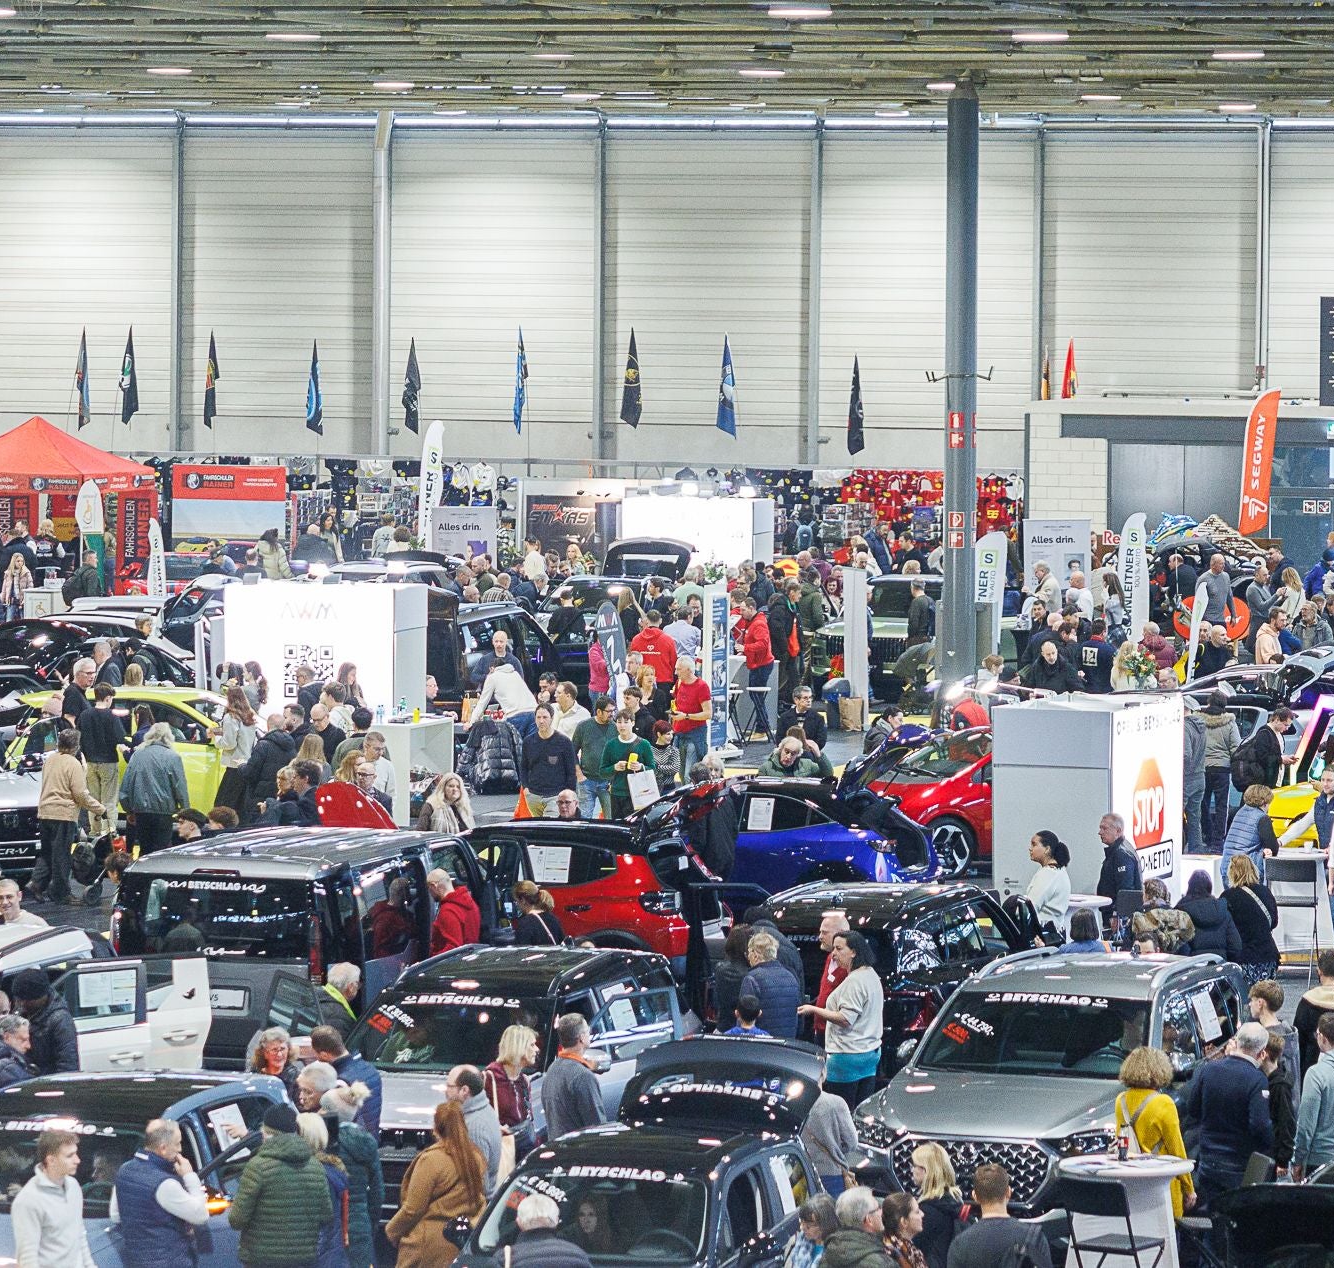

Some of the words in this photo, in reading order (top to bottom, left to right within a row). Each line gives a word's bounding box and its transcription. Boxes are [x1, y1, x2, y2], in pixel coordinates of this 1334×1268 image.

[1251, 413, 1267, 490] SEGWAY
[0, 498, 11, 538] SCHULEN
[125, 500, 136, 558] FAHRSCHULEN
[137, 500, 151, 558] RAINER
[438, 523, 460, 531] Alles
[462, 523, 482, 531] drin.
[1031, 536, 1054, 544] Alles
[1056, 535, 1076, 544] drin.
[1103, 530, 1120, 545] Re
[1131, 532, 1138, 542] S
[984, 553, 993, 564] S
[977, 570, 989, 599] NER
[1133, 785, 1164, 837] STOP
[1141, 848, 1172, 873] O-NETTO
[188, 881, 241, 891] BEYSCHLAG
[418, 994, 505, 1007] BEYSCHLAG
[1002, 992, 1092, 1006] BEYSCHLAG
[669, 1083, 763, 1100] BEYSCHLAG
[5, 1118, 97, 1135] BEYSAG
[568, 1165, 667, 1182] BEYSCHLAG
